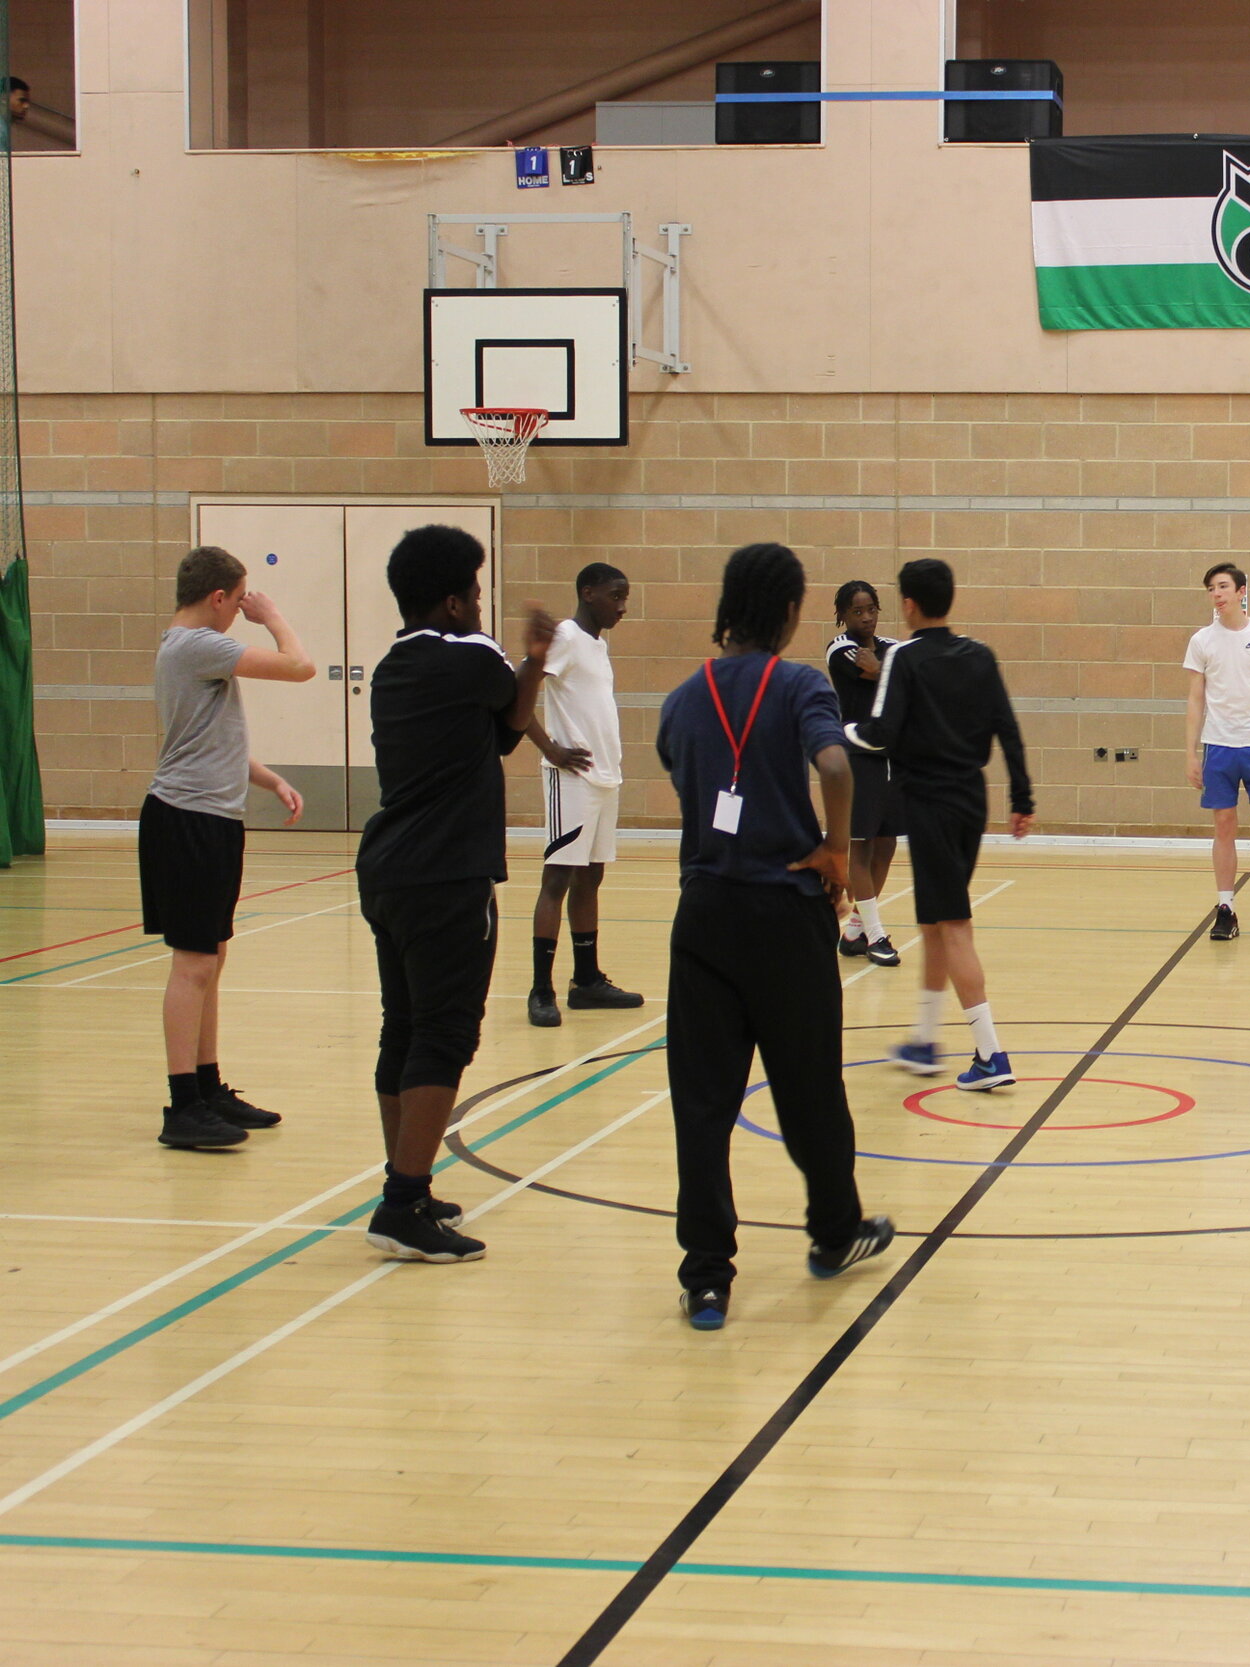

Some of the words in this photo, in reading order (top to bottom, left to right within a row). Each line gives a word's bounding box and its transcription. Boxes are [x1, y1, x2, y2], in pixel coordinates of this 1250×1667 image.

[530, 155, 537, 171] 1
[569, 160, 576, 175] 1
[518, 175, 549, 186] HOME
